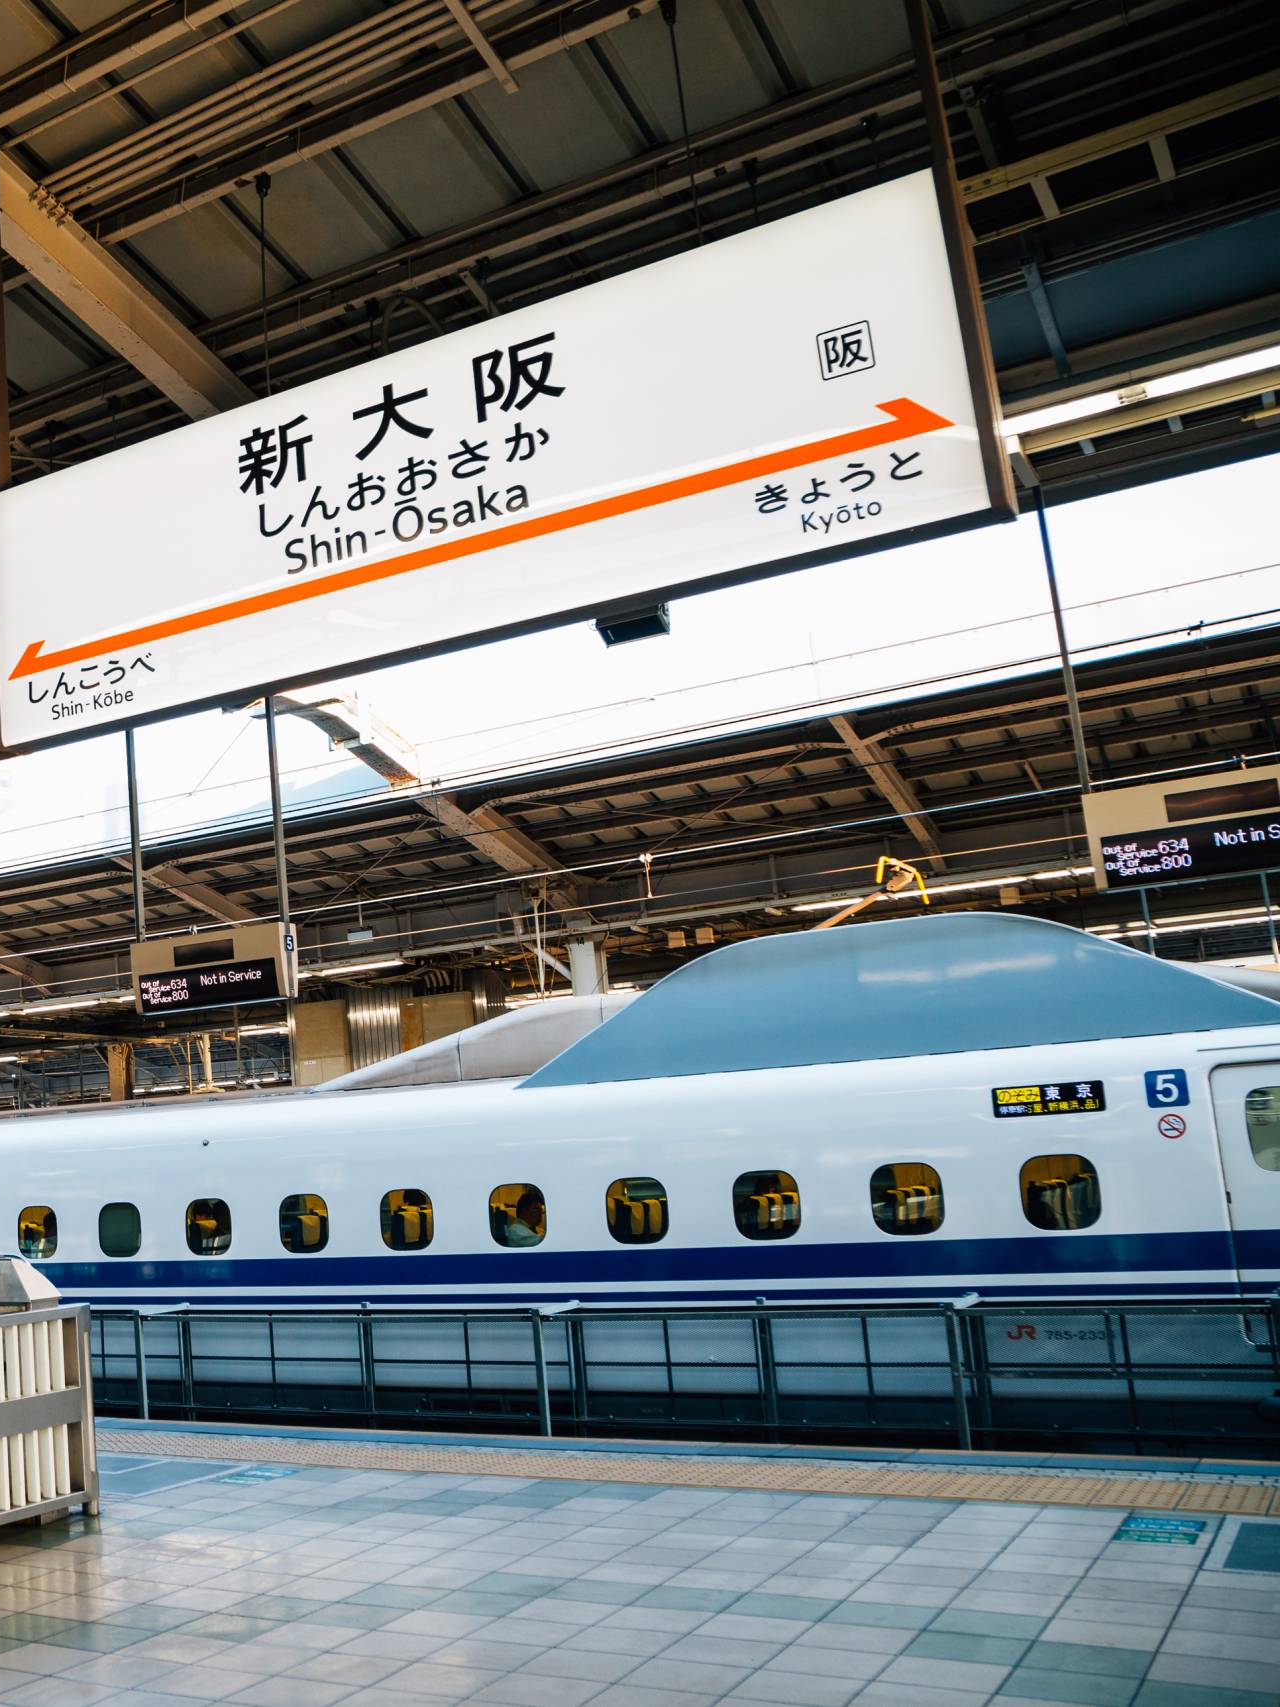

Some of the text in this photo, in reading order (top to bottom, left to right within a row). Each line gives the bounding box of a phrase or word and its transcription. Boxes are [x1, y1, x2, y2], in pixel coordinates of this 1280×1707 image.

[824, 333, 867, 376] 阪
[239, 332, 566, 495] 新大阪
[258, 421, 550, 538] しんおおさか
[754, 449, 923, 514] きょうと
[285, 477, 529, 575] Shin-Ōsaka
[800, 500, 882, 534] Kyōto
[27, 655, 156, 704] しんこうべ
[51, 690, 134, 721] Shin-Kōbe
[1157, 837, 1190, 854] 634
[1213, 828, 1248, 846] Not
[1249, 827, 1266, 842] in
[1160, 853, 1193, 870] 800
[286, 937, 294, 950] 5
[170, 978, 188, 990] 634
[200, 968, 262, 986] Not in Service
[172, 989, 189, 1001] 800
[997, 1083, 1094, 1103] のぞみ 東京
[1155, 1074, 1180, 1103] 5
[1007, 1324, 1117, 1341] JR 785-233
